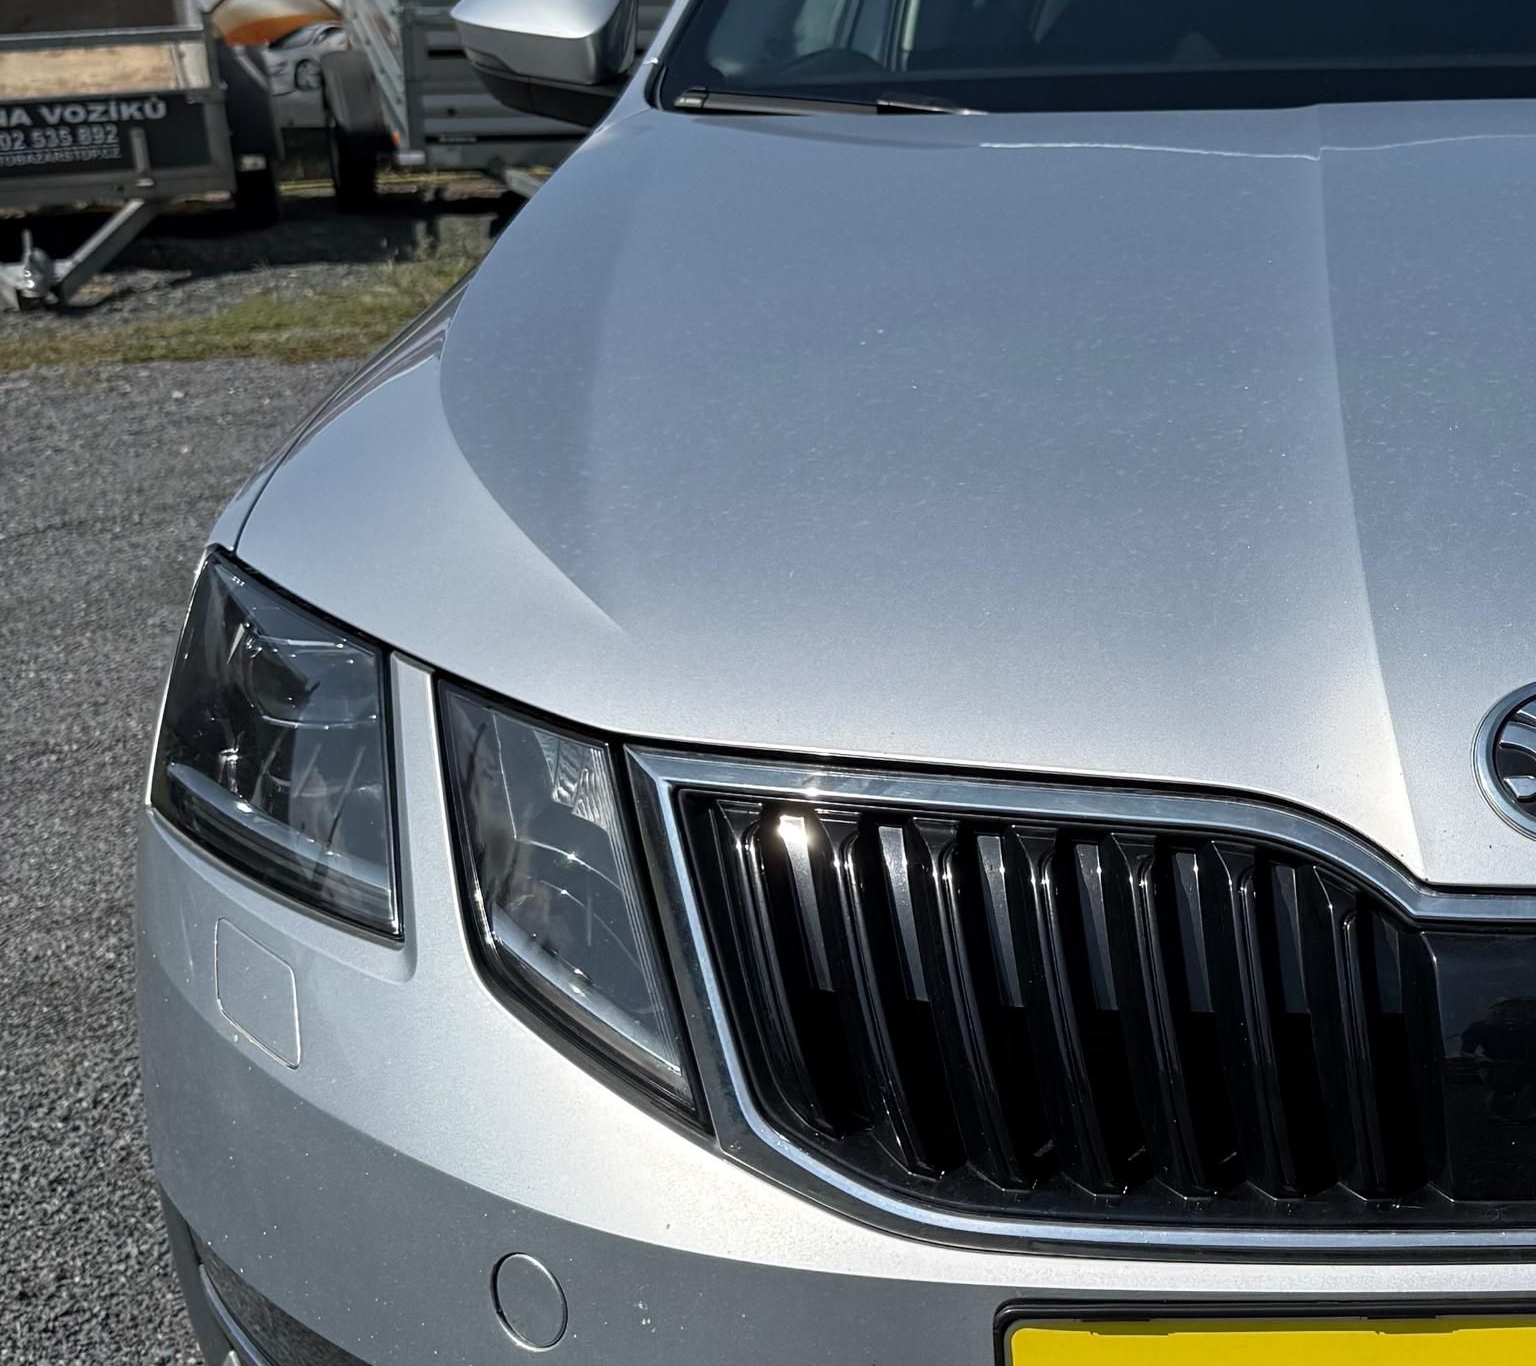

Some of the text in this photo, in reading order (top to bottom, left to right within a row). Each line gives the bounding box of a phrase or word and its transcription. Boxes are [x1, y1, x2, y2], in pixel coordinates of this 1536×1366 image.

[38, 96, 168, 126] VOZÍKŮ
[31, 126, 73, 148] 535
[77, 123, 119, 145] 892
